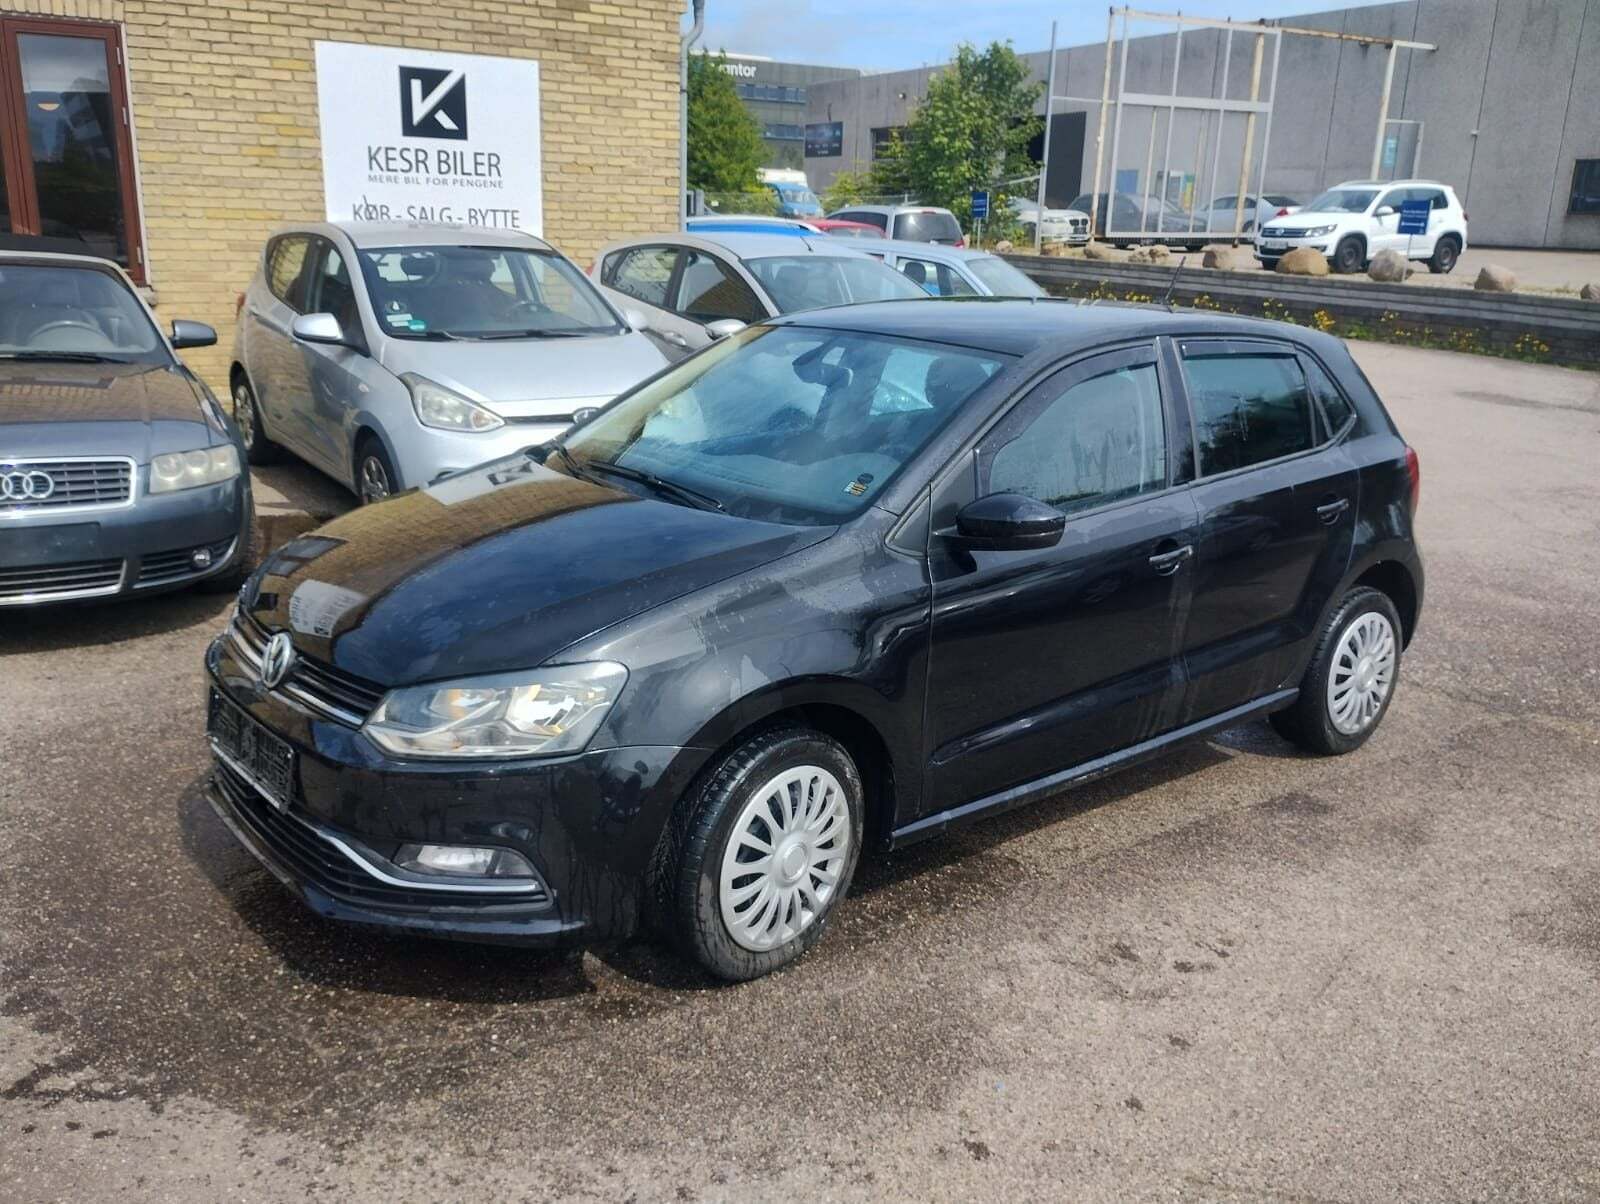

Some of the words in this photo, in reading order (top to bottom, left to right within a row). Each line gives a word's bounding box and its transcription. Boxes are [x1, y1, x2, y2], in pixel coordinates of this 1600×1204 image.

[368, 146, 429, 174] KESR
[437, 150, 501, 177] BILER
[368, 174, 399, 185] MERE
[403, 175, 421, 185] BIL
[425, 176, 449, 187] FOR
[452, 178, 503, 189] PENGENE
[468, 207, 521, 229] BYTTE
